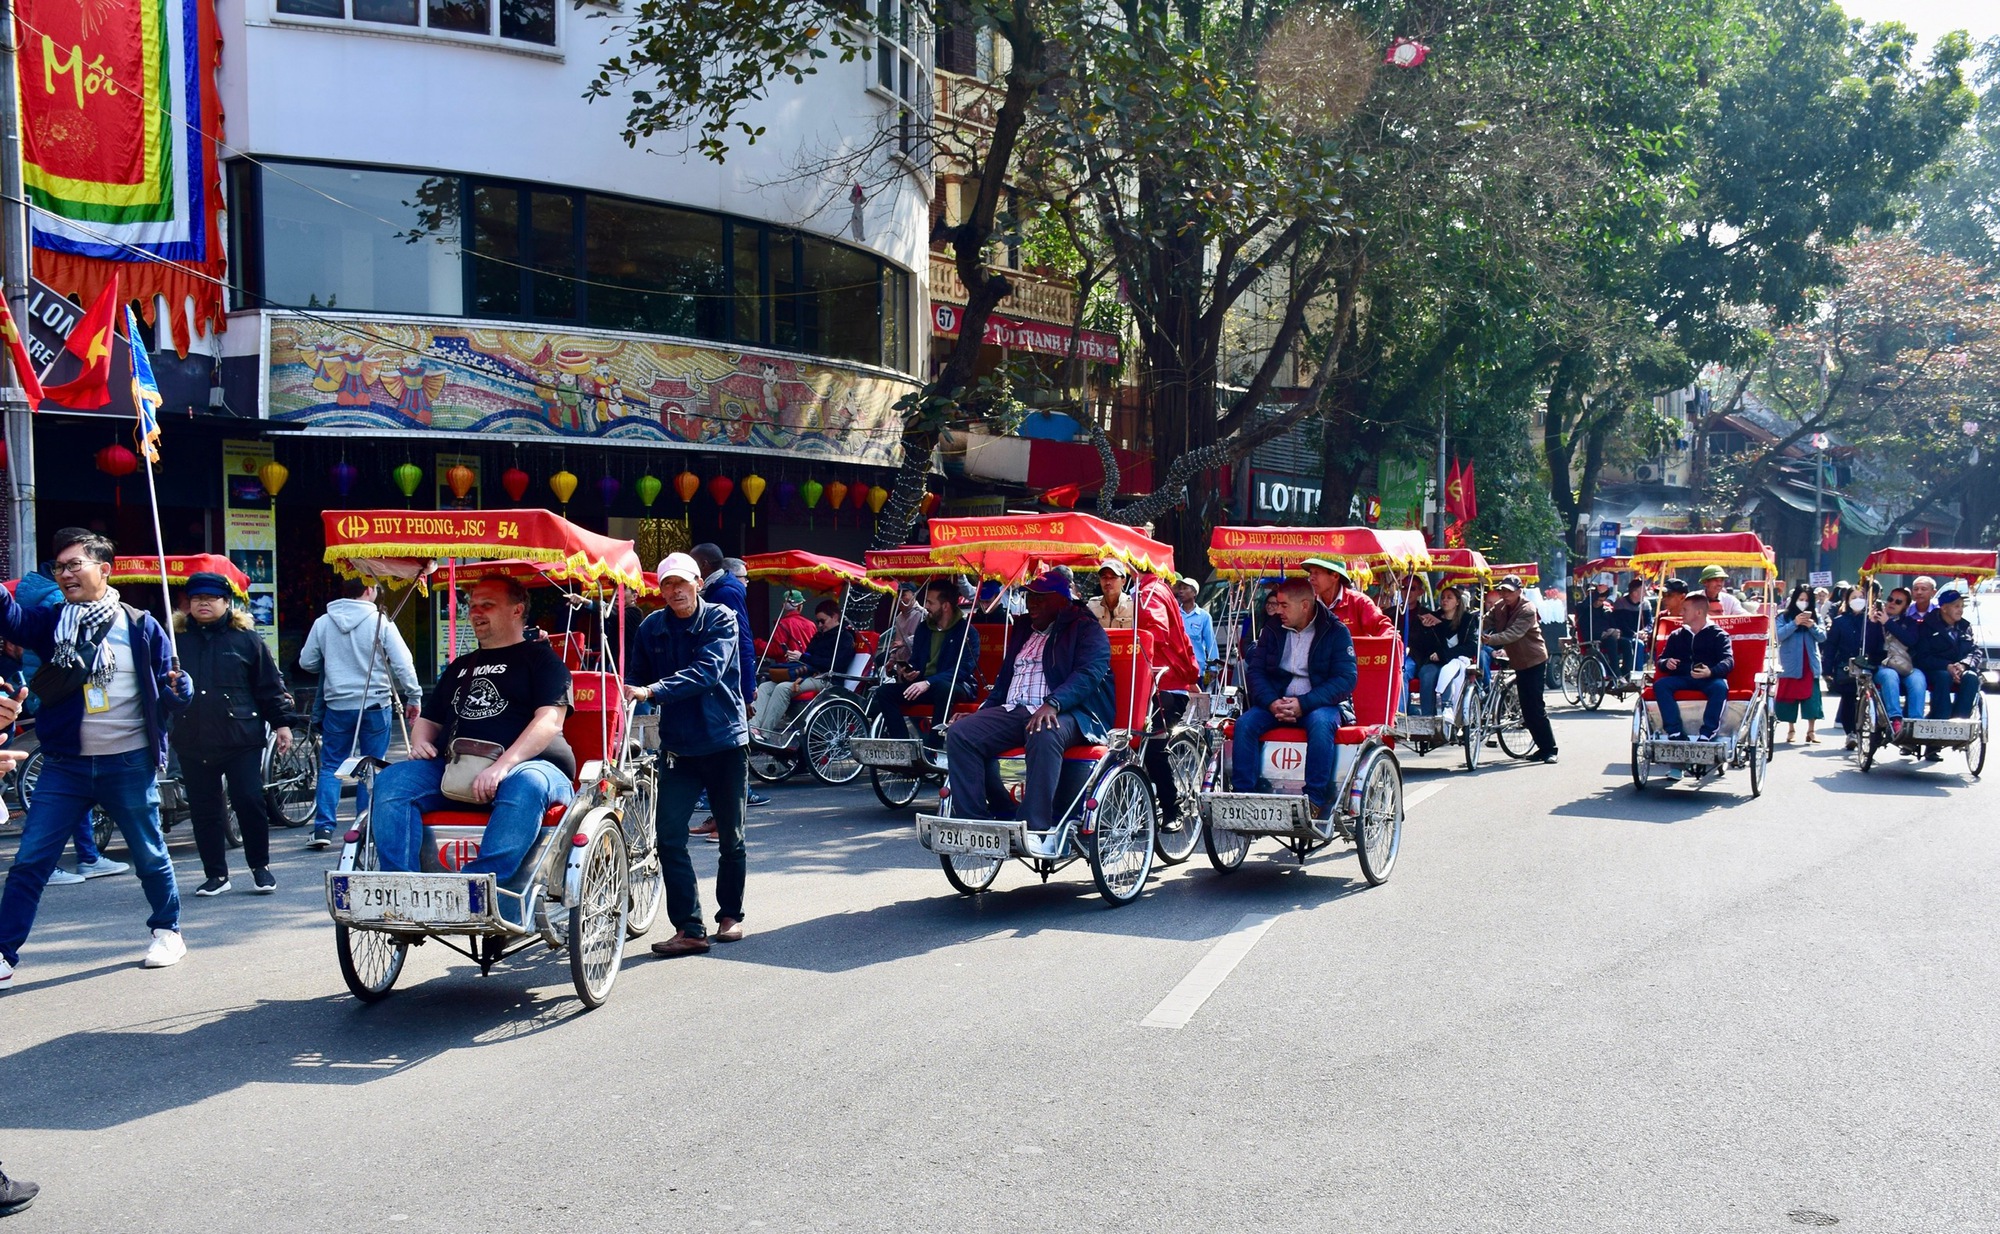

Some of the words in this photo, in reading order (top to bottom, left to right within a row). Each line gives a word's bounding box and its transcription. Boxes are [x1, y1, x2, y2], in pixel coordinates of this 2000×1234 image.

[42, 35, 118, 109] Mới
[29, 292, 75, 340] LON
[939, 311, 953, 328] 57
[373, 518, 401, 534] HUY
[498, 521, 519, 539] 54
[959, 526, 980, 537] HUY
[1050, 522, 1064, 534] 33
[1249, 533, 1267, 544] HUY
[1331, 534, 1345, 546] 38
[171, 561, 184, 571] 08
[888, 557, 902, 565] HUY
[1373, 655, 1387, 665] 38
[575, 689, 595, 700] JSC
[1221, 807, 1282, 821] 29XL-0073
[940, 831, 1000, 849] 29XL-0068
